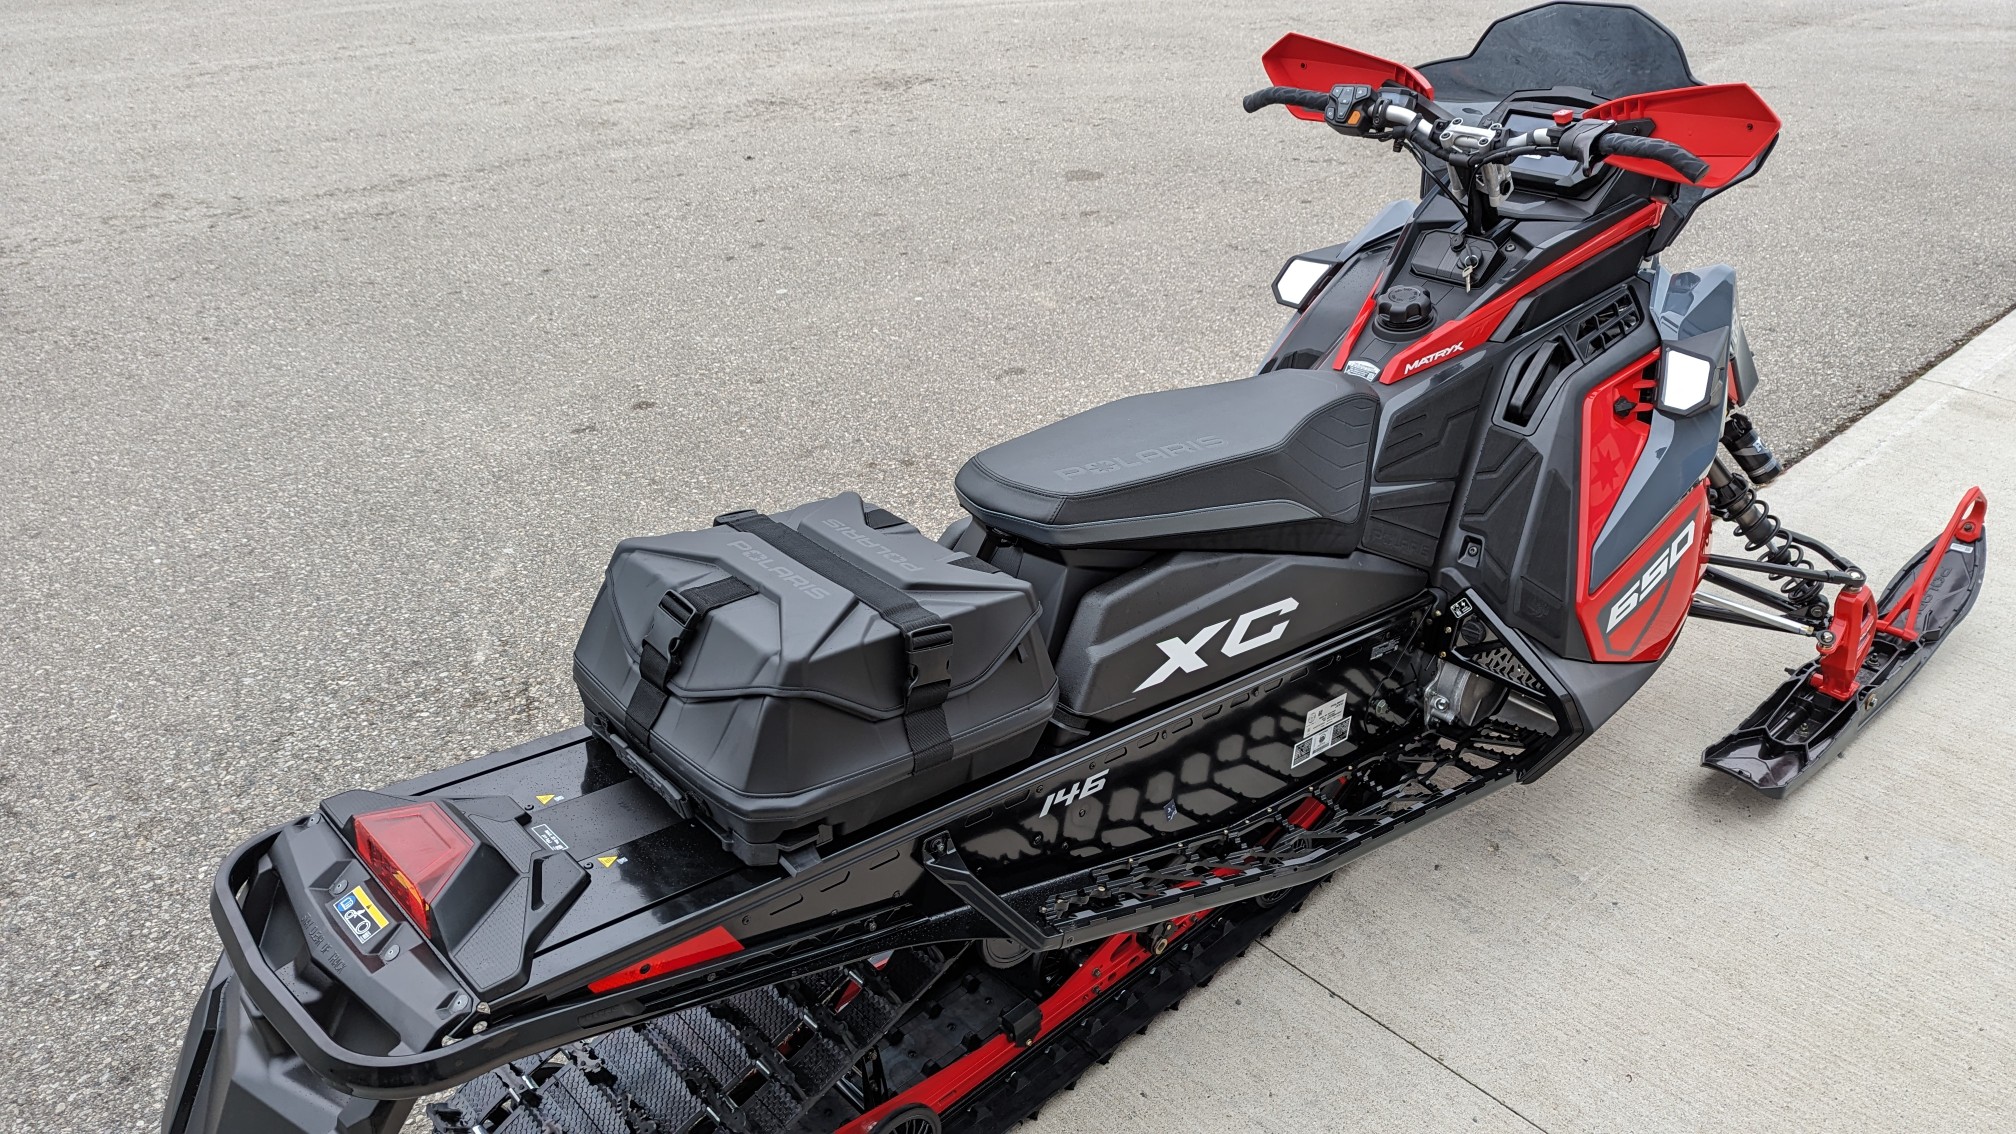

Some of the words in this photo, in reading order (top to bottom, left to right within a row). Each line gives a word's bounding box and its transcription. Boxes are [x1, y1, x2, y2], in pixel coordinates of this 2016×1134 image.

[1404, 341, 1465, 375] MATRYX
[1053, 435, 1225, 481] POLARIS
[726, 540, 831, 600] POLARIS
[822, 518, 925, 572] POLARIS
[1606, 519, 1696, 634] 650
[1132, 597, 1300, 693] XC
[1039, 768, 1110, 819] 146
